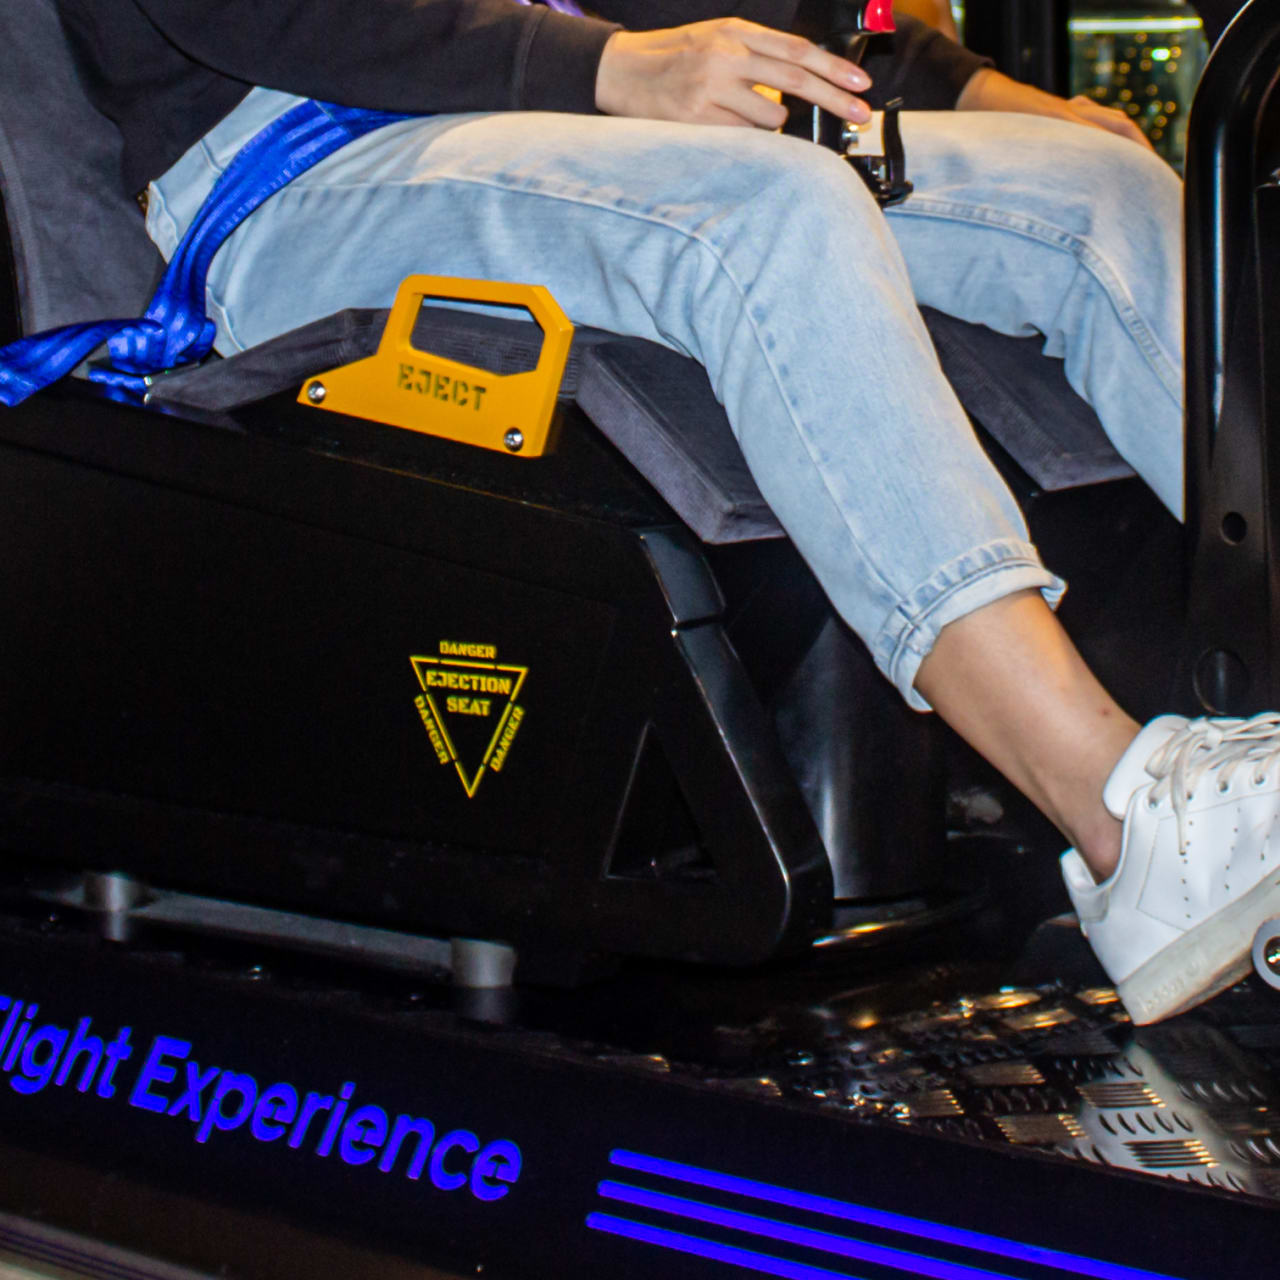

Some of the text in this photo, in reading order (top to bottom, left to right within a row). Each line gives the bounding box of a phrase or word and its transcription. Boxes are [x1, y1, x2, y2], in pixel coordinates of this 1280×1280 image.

[398, 363, 488, 412] EJECT
[438, 639, 498, 660] DANGER
[425, 668, 513, 696] EJECTION
[446, 694, 493, 718] SEAT
[413, 693, 451, 767] DANGER
[488, 704, 526, 773] DANGER
[128, 1034, 522, 1202] Experience
